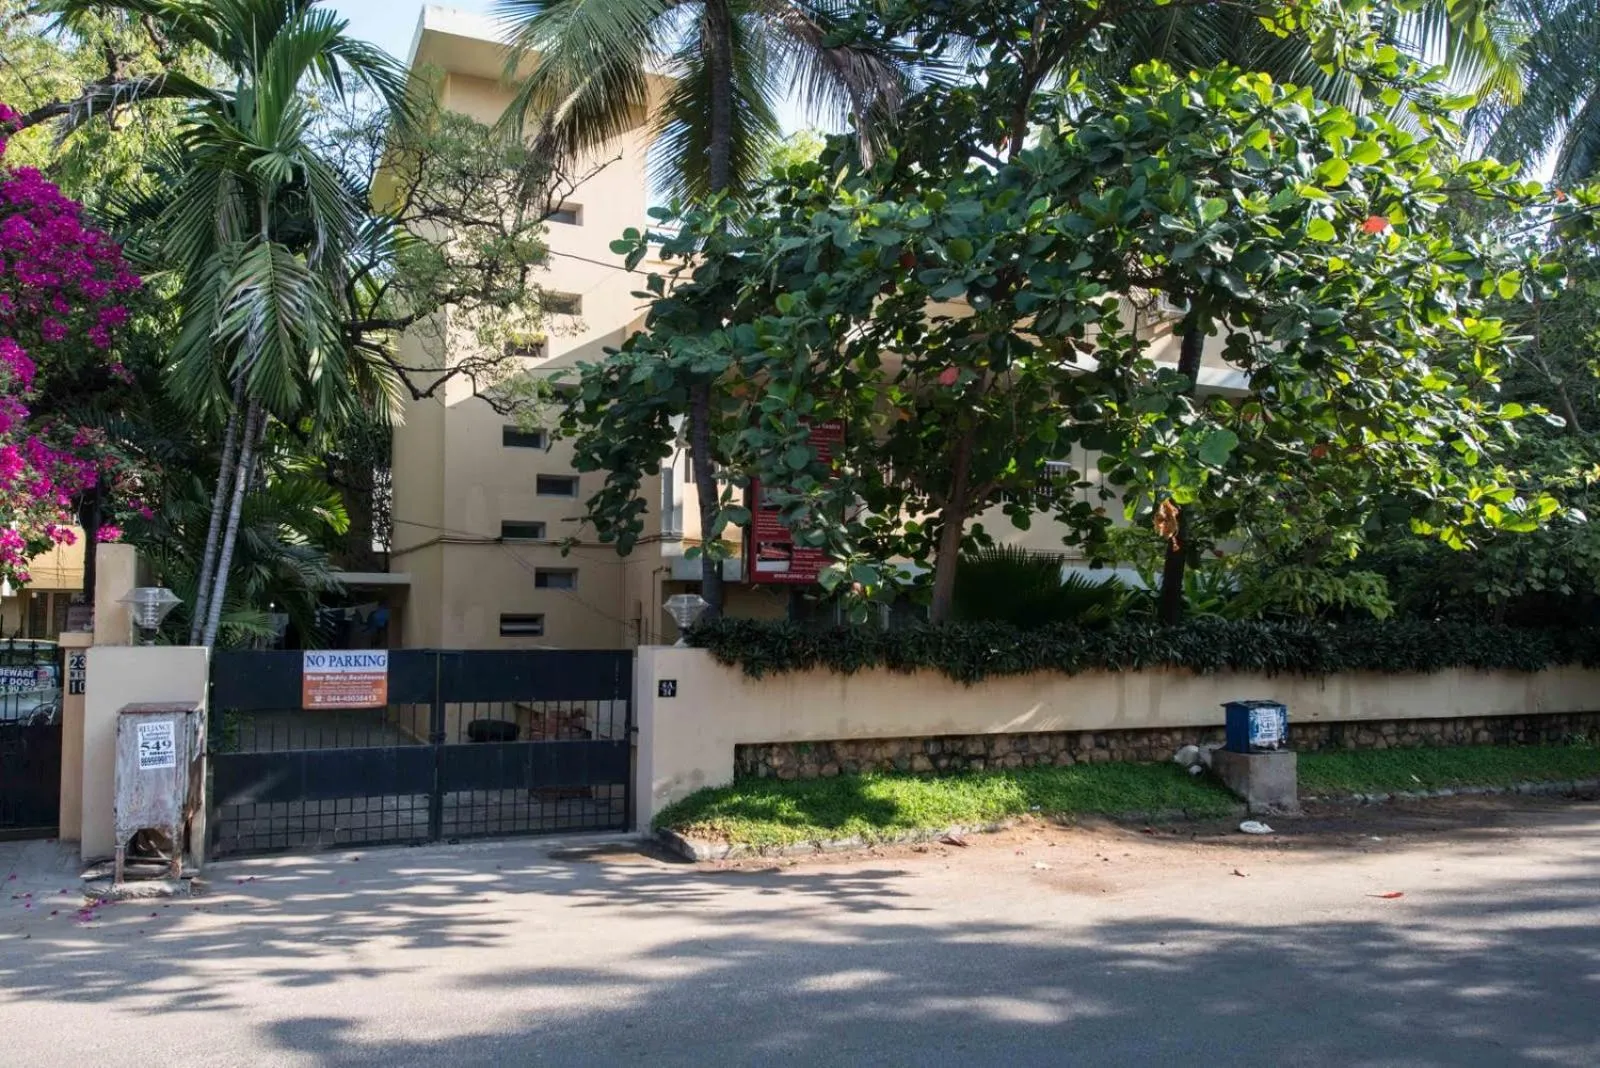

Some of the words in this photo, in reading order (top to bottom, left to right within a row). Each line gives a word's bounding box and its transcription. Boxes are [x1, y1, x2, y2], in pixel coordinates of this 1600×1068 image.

[70, 656, 86, 669] 23
[306, 655, 325, 667] NO
[329, 655, 386, 667] PARKING
[10, 677, 36, 687] DOGS
[141, 740, 172, 751] 549
